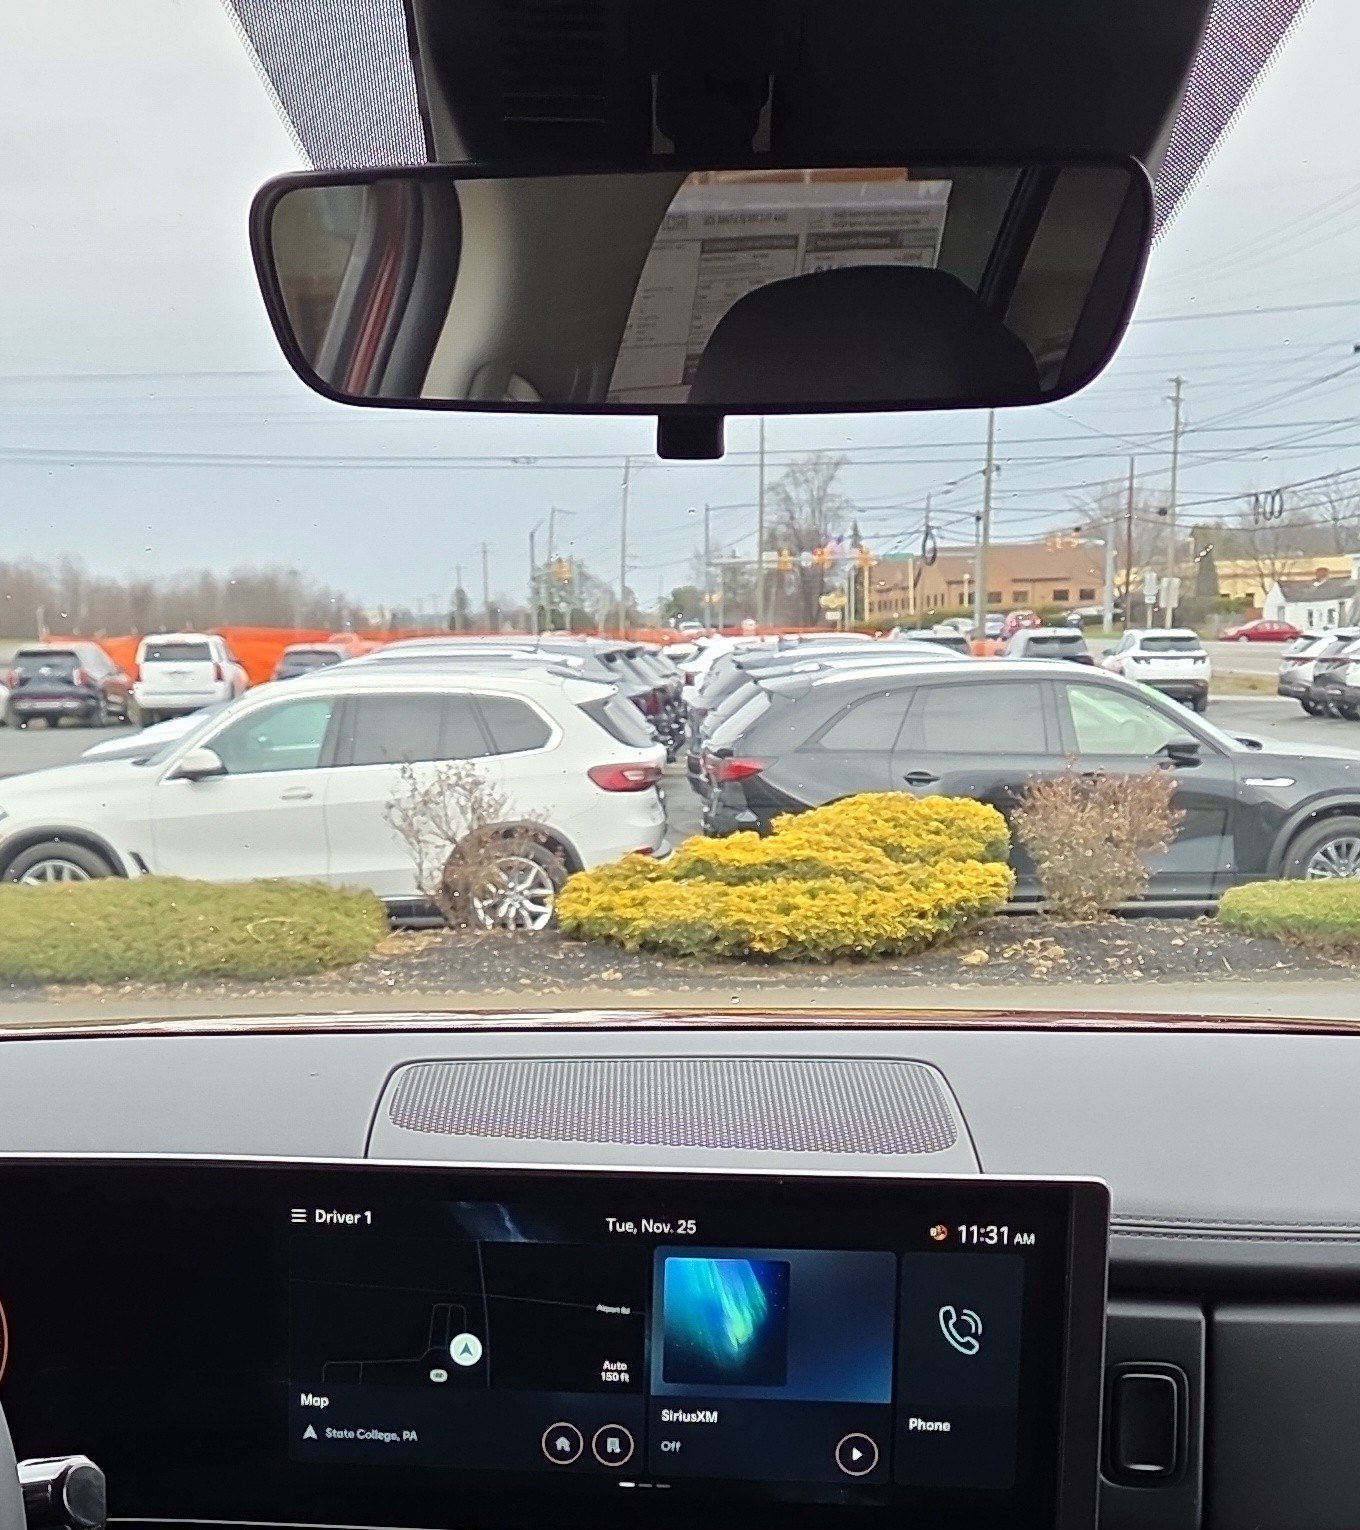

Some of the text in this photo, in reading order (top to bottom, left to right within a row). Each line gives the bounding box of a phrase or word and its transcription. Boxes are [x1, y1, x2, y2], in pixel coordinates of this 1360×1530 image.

[315, 1208, 372, 1225] Driver 1
[605, 1217, 697, 1235] Tue, Nov. 25
[957, 1224, 1036, 1245] 11:31 AM
[602, 1359, 628, 1371] Auto
[600, 1371, 630, 1383] 150 ft
[300, 1392, 330, 1409] Map
[661, 1408, 719, 1424] SiriusXM
[908, 1417, 951, 1432] Phone
[324, 1427, 419, 1442] State College, PA
[660, 1440, 682, 1453] Off
